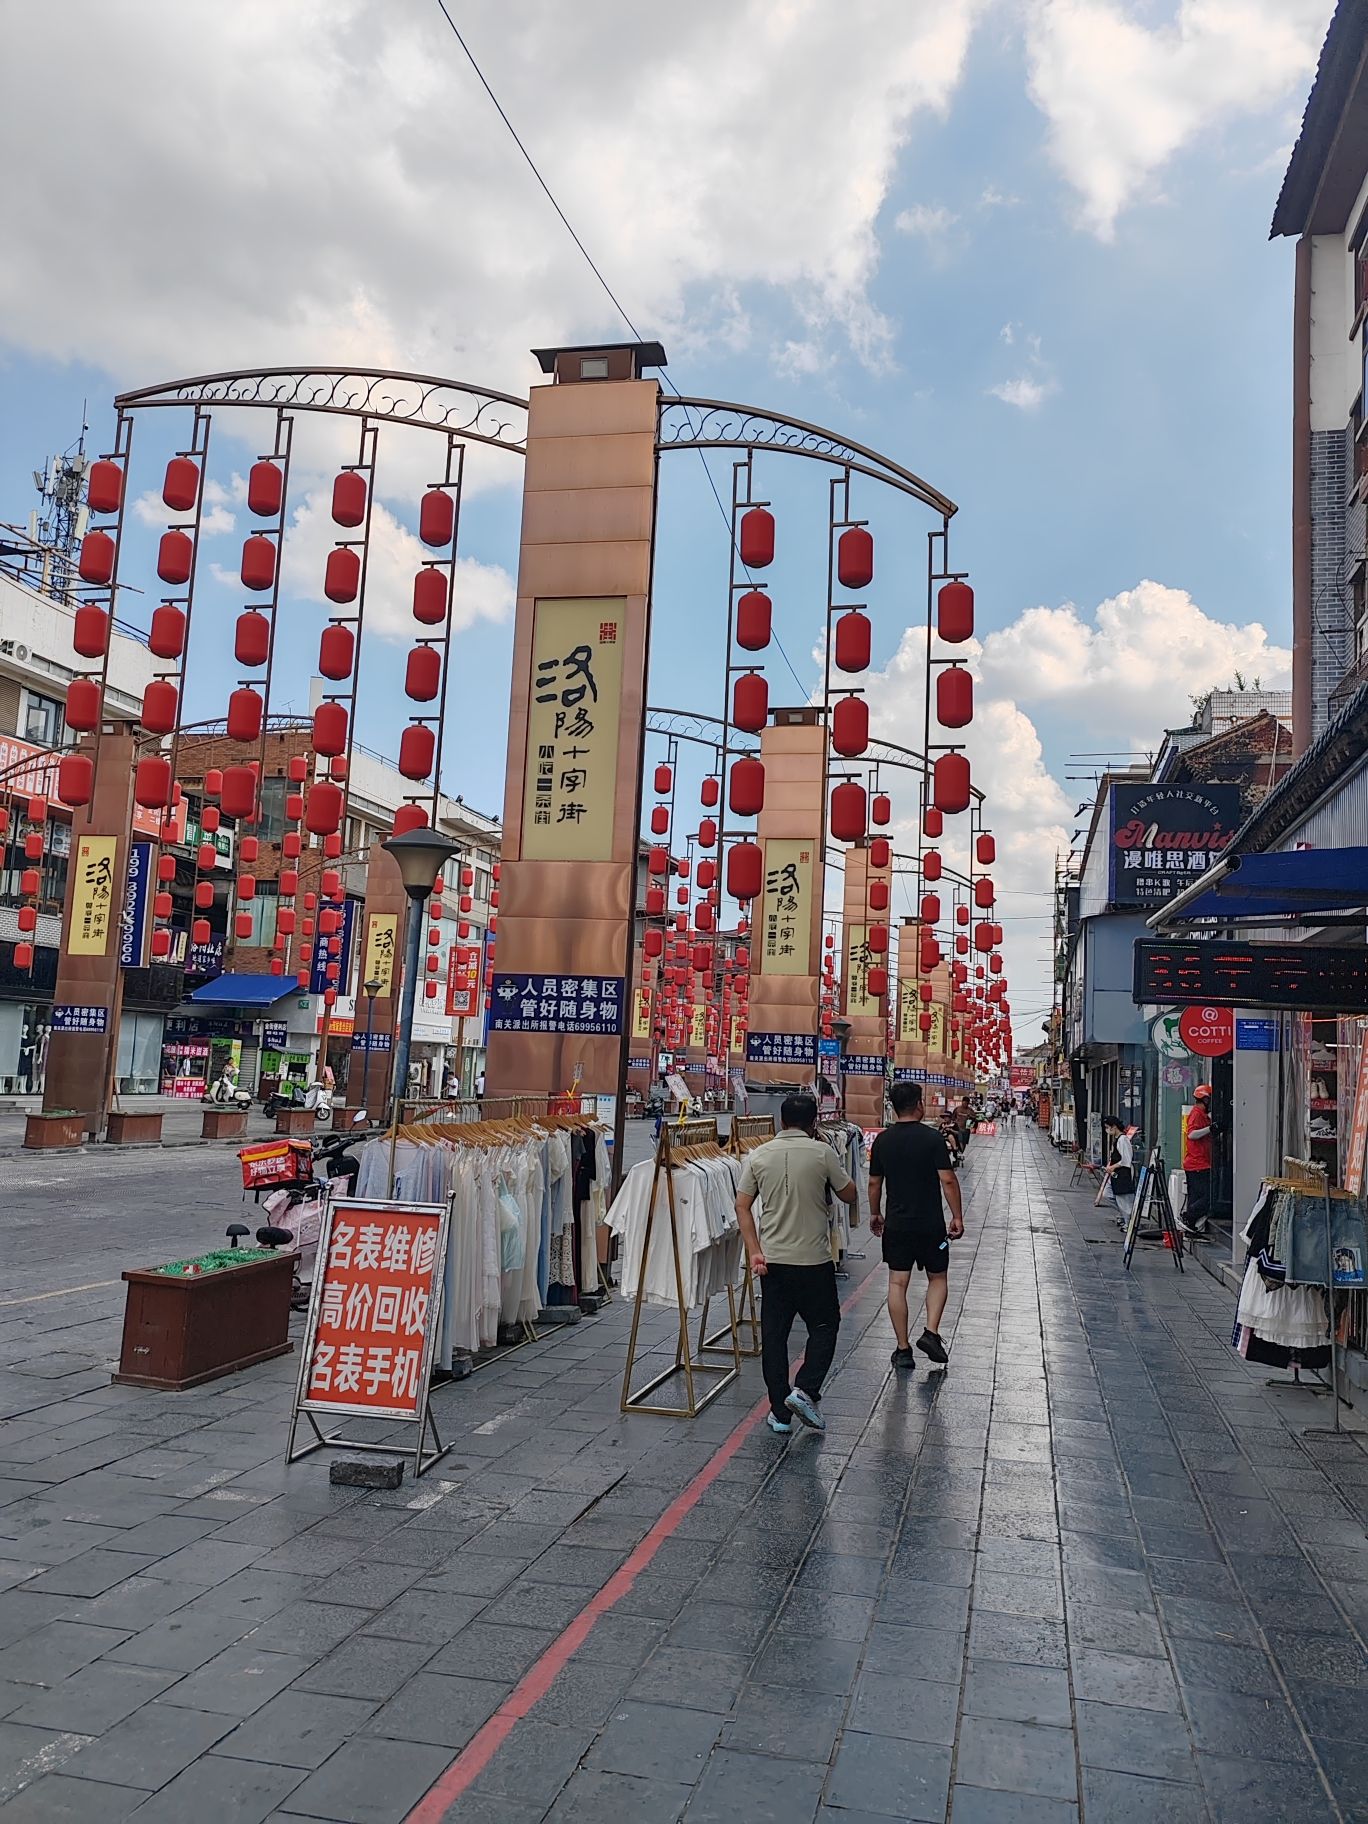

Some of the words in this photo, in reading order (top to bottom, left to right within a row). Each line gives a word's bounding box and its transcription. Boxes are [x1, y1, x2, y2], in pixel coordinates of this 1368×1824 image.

[520, 978, 618, 998] 人员密集区
[64, 1007, 105, 1018] 人员密集区
[520, 998, 618, 1020] 管好随身物
[64, 1017, 105, 1027] 管好随身物
[1188, 1026, 1232, 1037] COTTI
[762, 1035, 814, 1047] 人员密集区
[762, 1045, 814, 1057] 管好随身物
[329, 1221, 438, 1275] 名表维修
[318, 1279, 429, 1336] 高价回收
[309, 1340, 420, 1399] 名表手机
